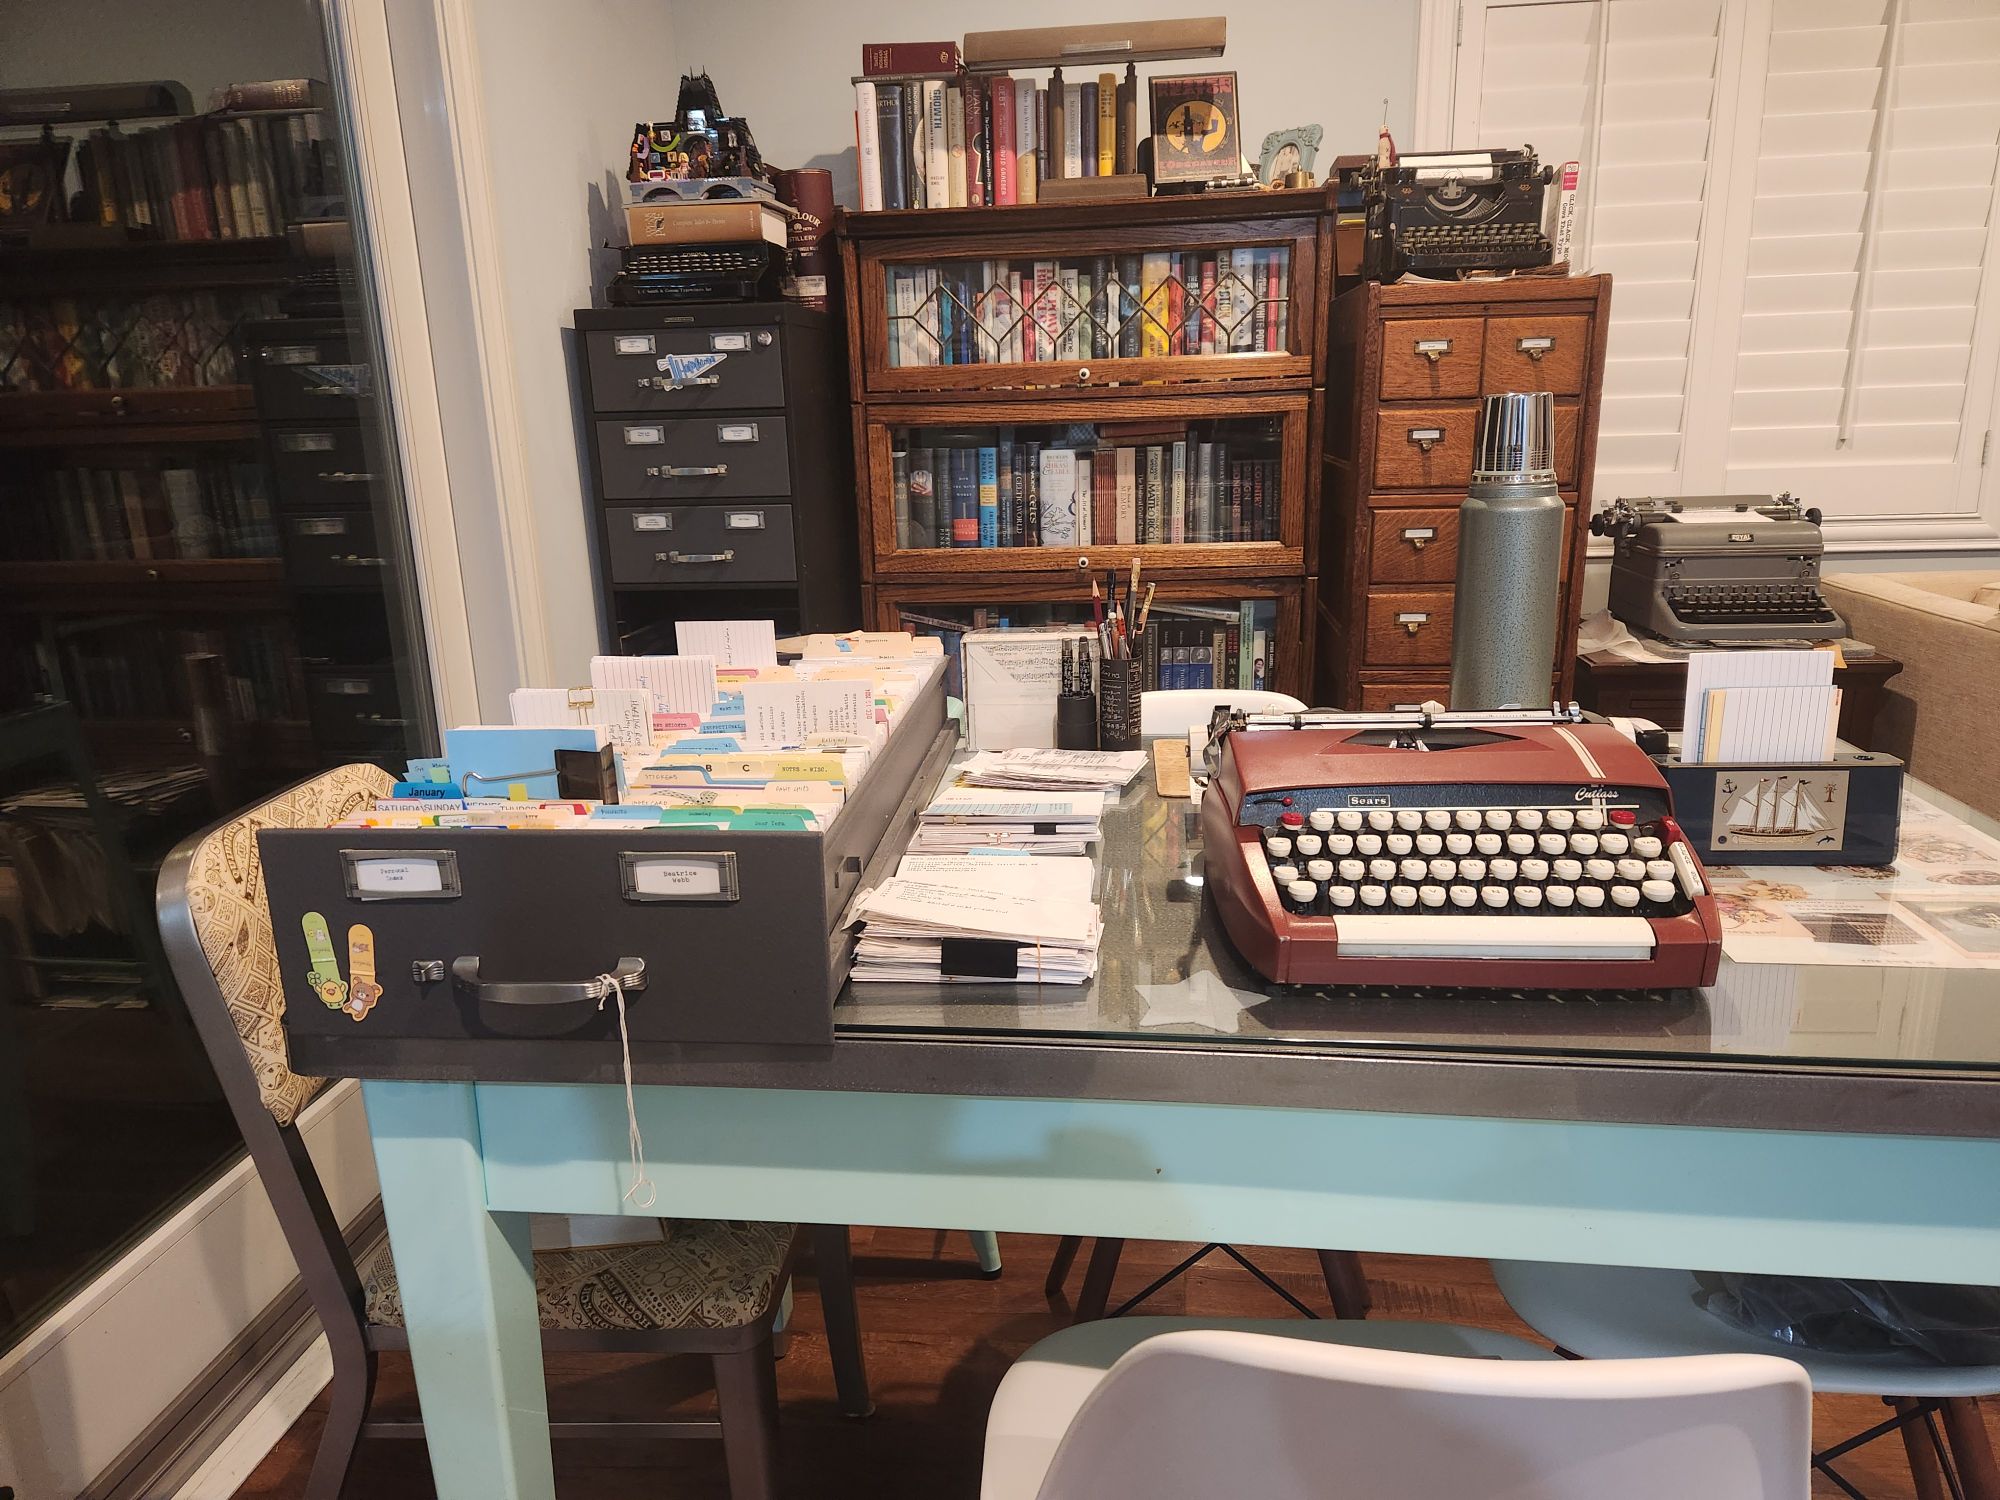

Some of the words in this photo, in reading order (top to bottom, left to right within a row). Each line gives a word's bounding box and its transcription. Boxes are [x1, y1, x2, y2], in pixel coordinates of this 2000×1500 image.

[973, 89, 981, 115] DAN
[998, 86, 1006, 107] DEBT
[933, 89, 942, 129] GROWTH
[1566, 193, 1576, 218] CLICK,
[787, 211, 821, 228] ERLOUR
[788, 234, 817, 242] STILLERY
[1565, 219, 1573, 244] CLACK,
[1556, 238, 1564, 254] Type
[1218, 285, 1231, 318] ACTION
[1255, 304, 1265, 327] WHITE
[1067, 329, 1075, 353] Game
[1255, 329, 1265, 353] POVER
[1254, 465, 1262, 508] COUNTRY
[1147, 483, 1156, 516] MATTEO
[1148, 518, 1156, 540] RICCI
[706, 764, 712, 772] B
[742, 764, 750, 772] C
[408, 788, 446, 798] January
[1351, 796, 1387, 805] Sears
[1574, 786, 1620, 802] Cutlass
